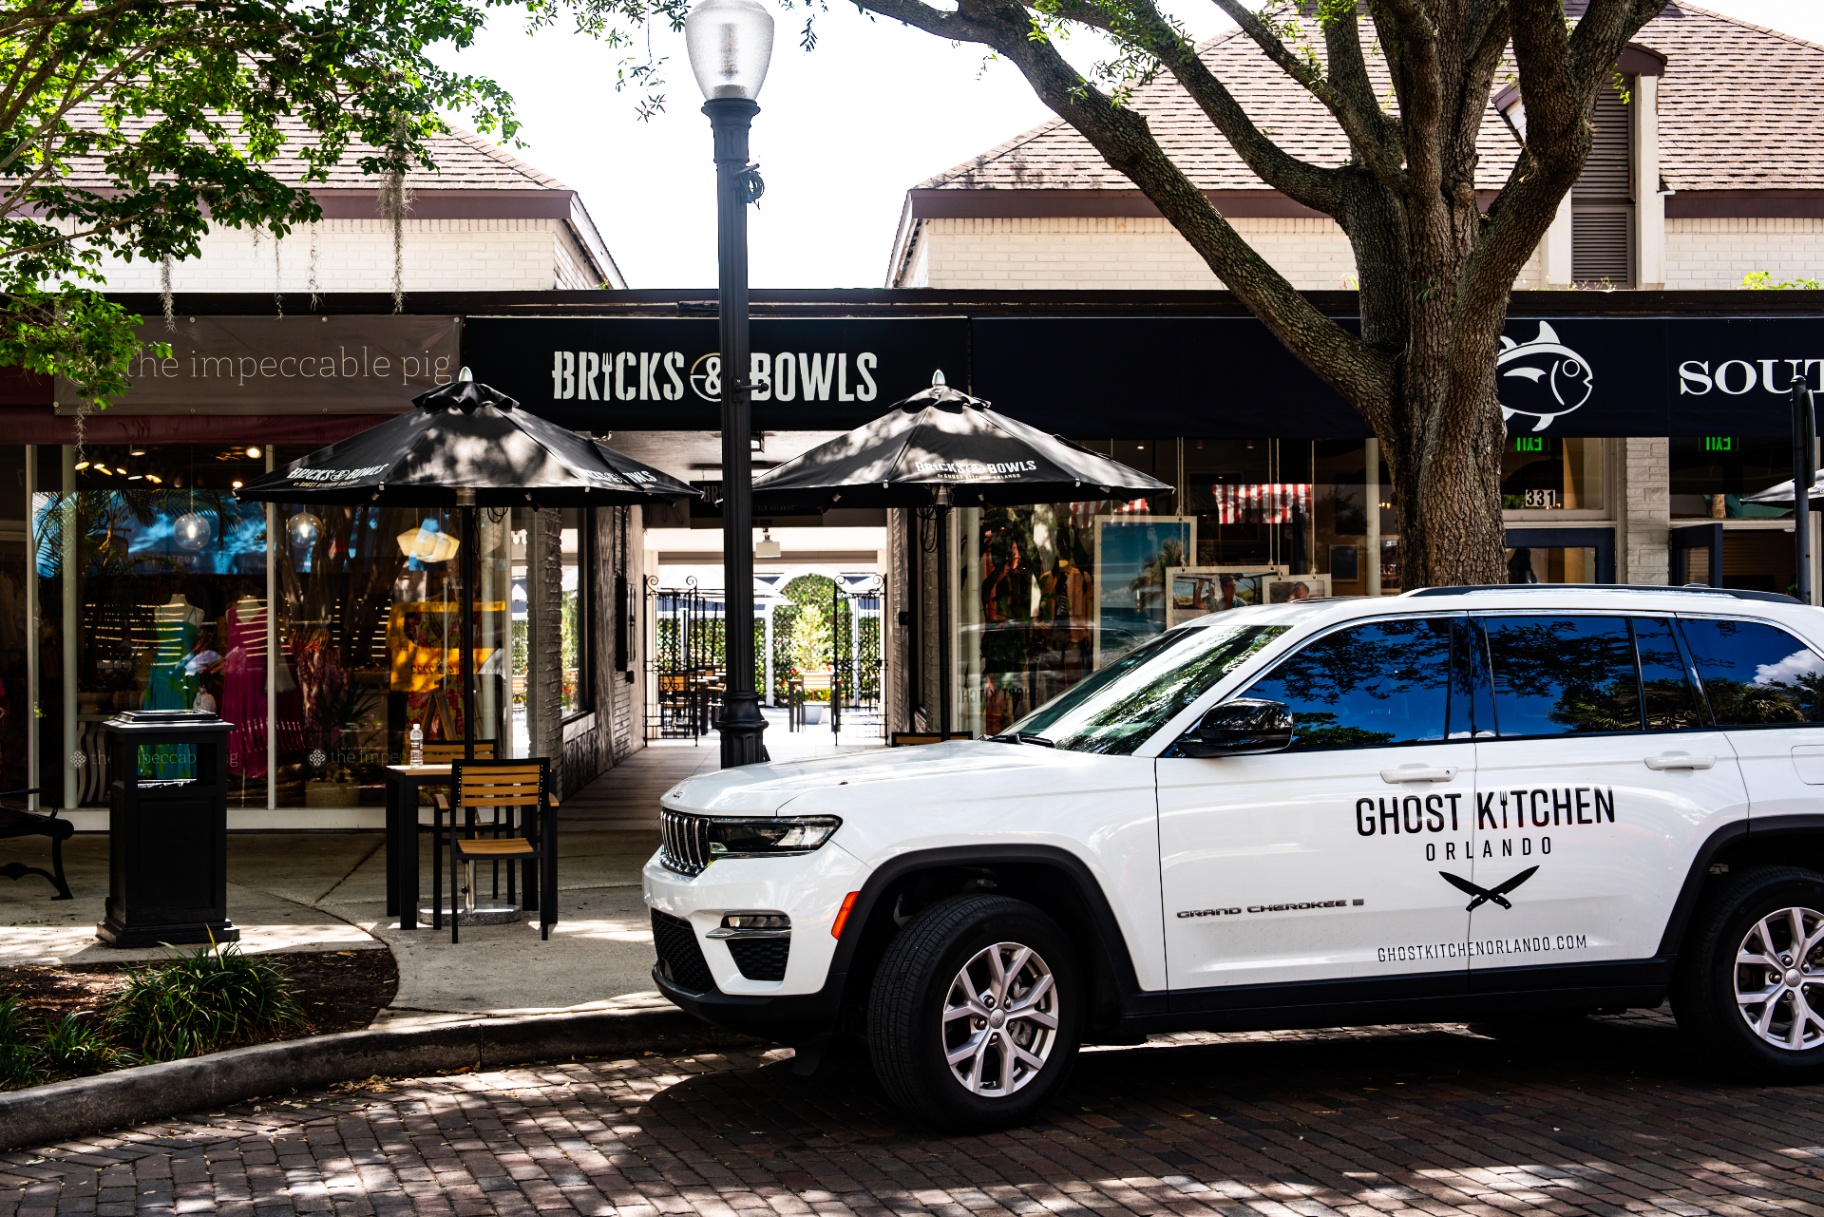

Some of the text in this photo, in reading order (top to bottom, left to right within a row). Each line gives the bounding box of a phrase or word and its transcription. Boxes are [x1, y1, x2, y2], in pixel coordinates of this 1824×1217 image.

[123, 345, 452, 387] the impeccable pig
[552, 350, 685, 401] BRICKS
[749, 352, 878, 402] BOWLS
[286, 467, 334, 481] BRICKS
[345, 463, 390, 480] BOWLS
[915, 461, 965, 473] BRICKS
[986, 460, 1037, 474] BOWLS
[1526, 489, 1554, 506] 331
[1355, 786, 1616, 837] GHOST KITCHEN
[1425, 836, 1552, 862] ORLANDO
[1176, 899, 1347, 919] GRAND CHEROKEE
[1377, 934, 1587, 963] GHOSTKITCHENORLANDO.COM
